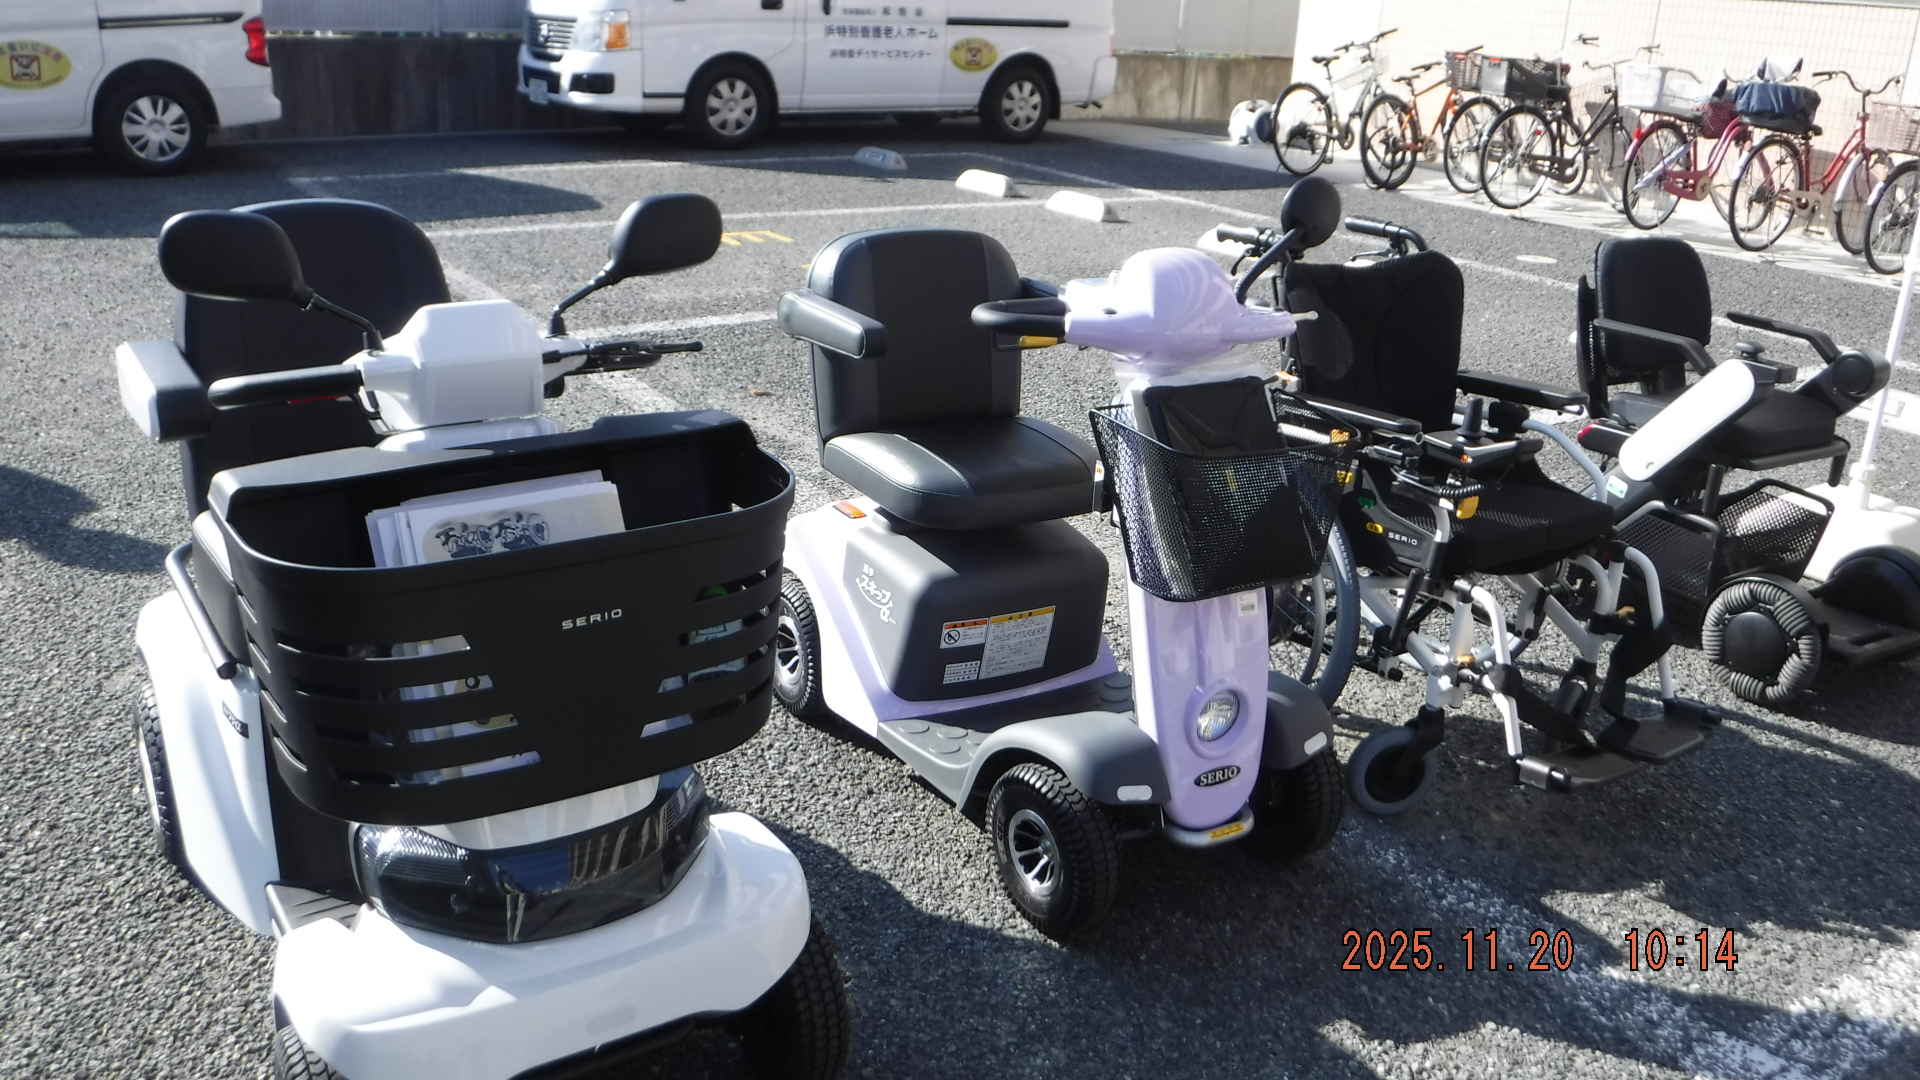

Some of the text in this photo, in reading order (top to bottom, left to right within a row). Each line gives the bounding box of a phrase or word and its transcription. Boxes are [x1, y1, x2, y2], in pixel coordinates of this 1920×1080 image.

[1388, 531, 1418, 546] SERIO
[561, 608, 622, 630] SERIO
[1199, 766, 1238, 786] SERIO
